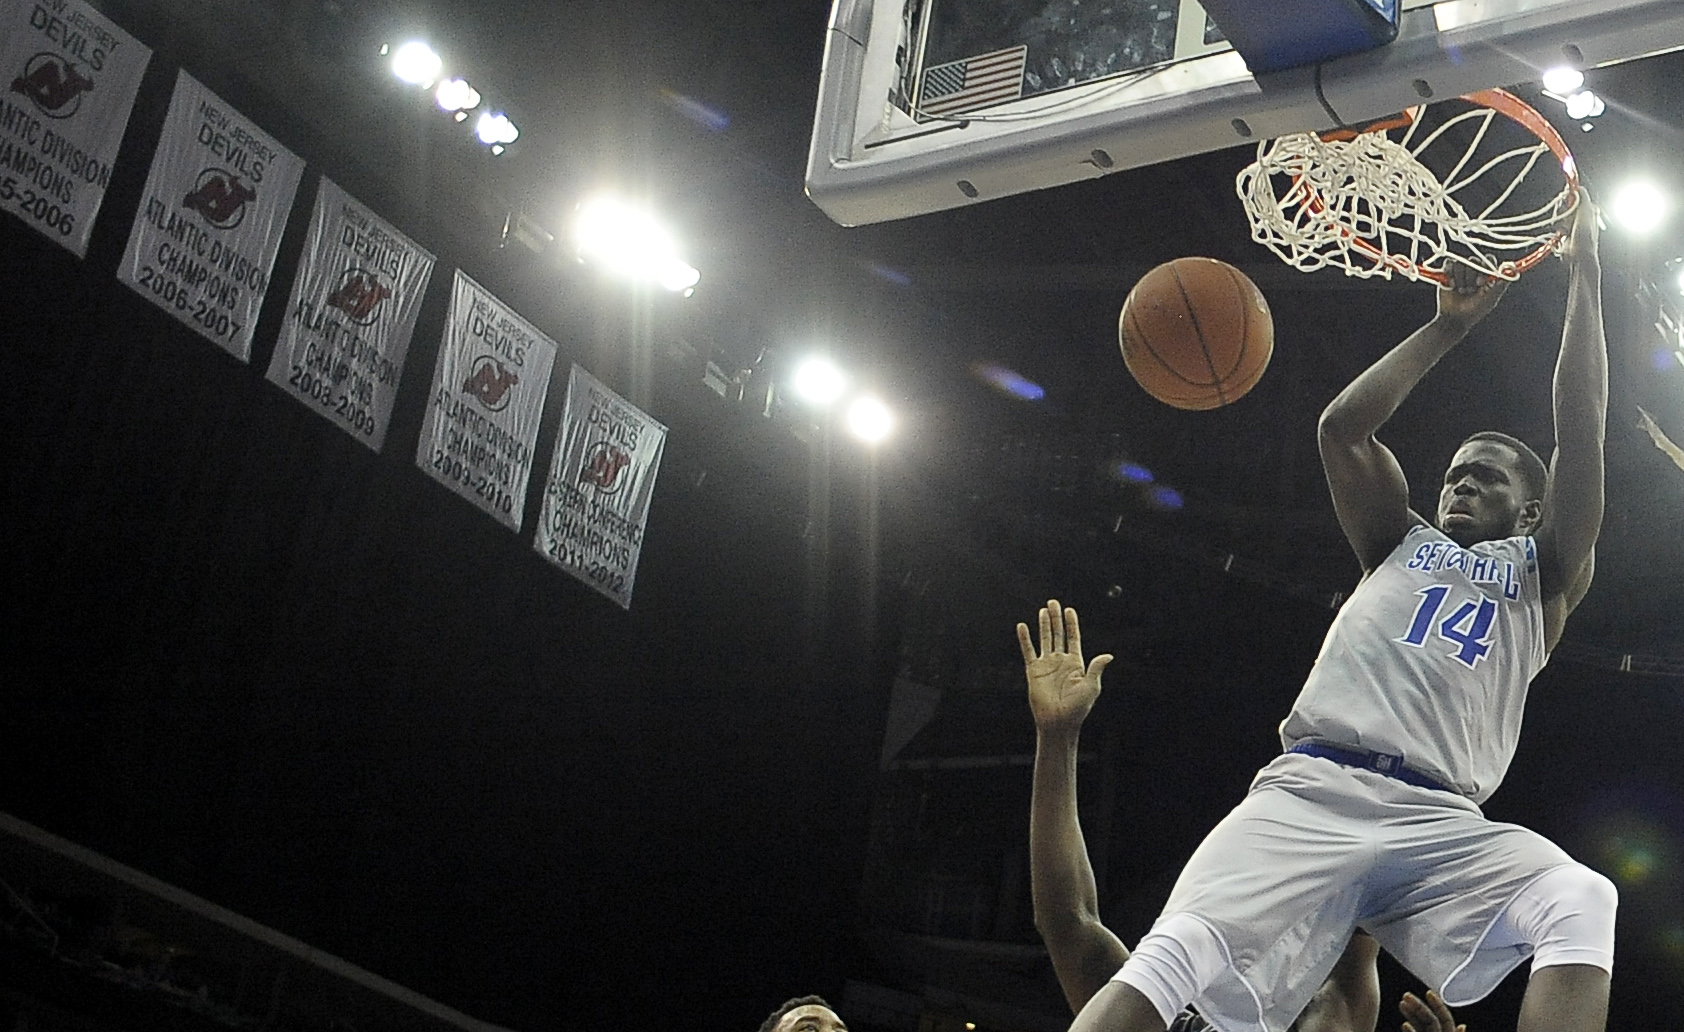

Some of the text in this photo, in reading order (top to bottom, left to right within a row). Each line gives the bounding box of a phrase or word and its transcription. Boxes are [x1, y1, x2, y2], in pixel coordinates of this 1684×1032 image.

[29, 3, 106, 72] DEVILS
[66, 11, 121, 54] JERSEY
[41, 129, 112, 190] DIVISION
[198, 122, 265, 184] DEVILS
[199, 100, 278, 166] NEW JERSEY
[145, 195, 268, 299] ATLANTIC DIVISION
[157, 242, 240, 312] CHAMPIONS
[342, 225, 399, 281] DEVILS
[138, 265, 243, 343] 2006-2007
[472, 316, 526, 368] DEVILS
[587, 402, 639, 452] DEVILS
[548, 536, 626, 595] 2011-2012
[1393, 583, 1499, 671] 14
